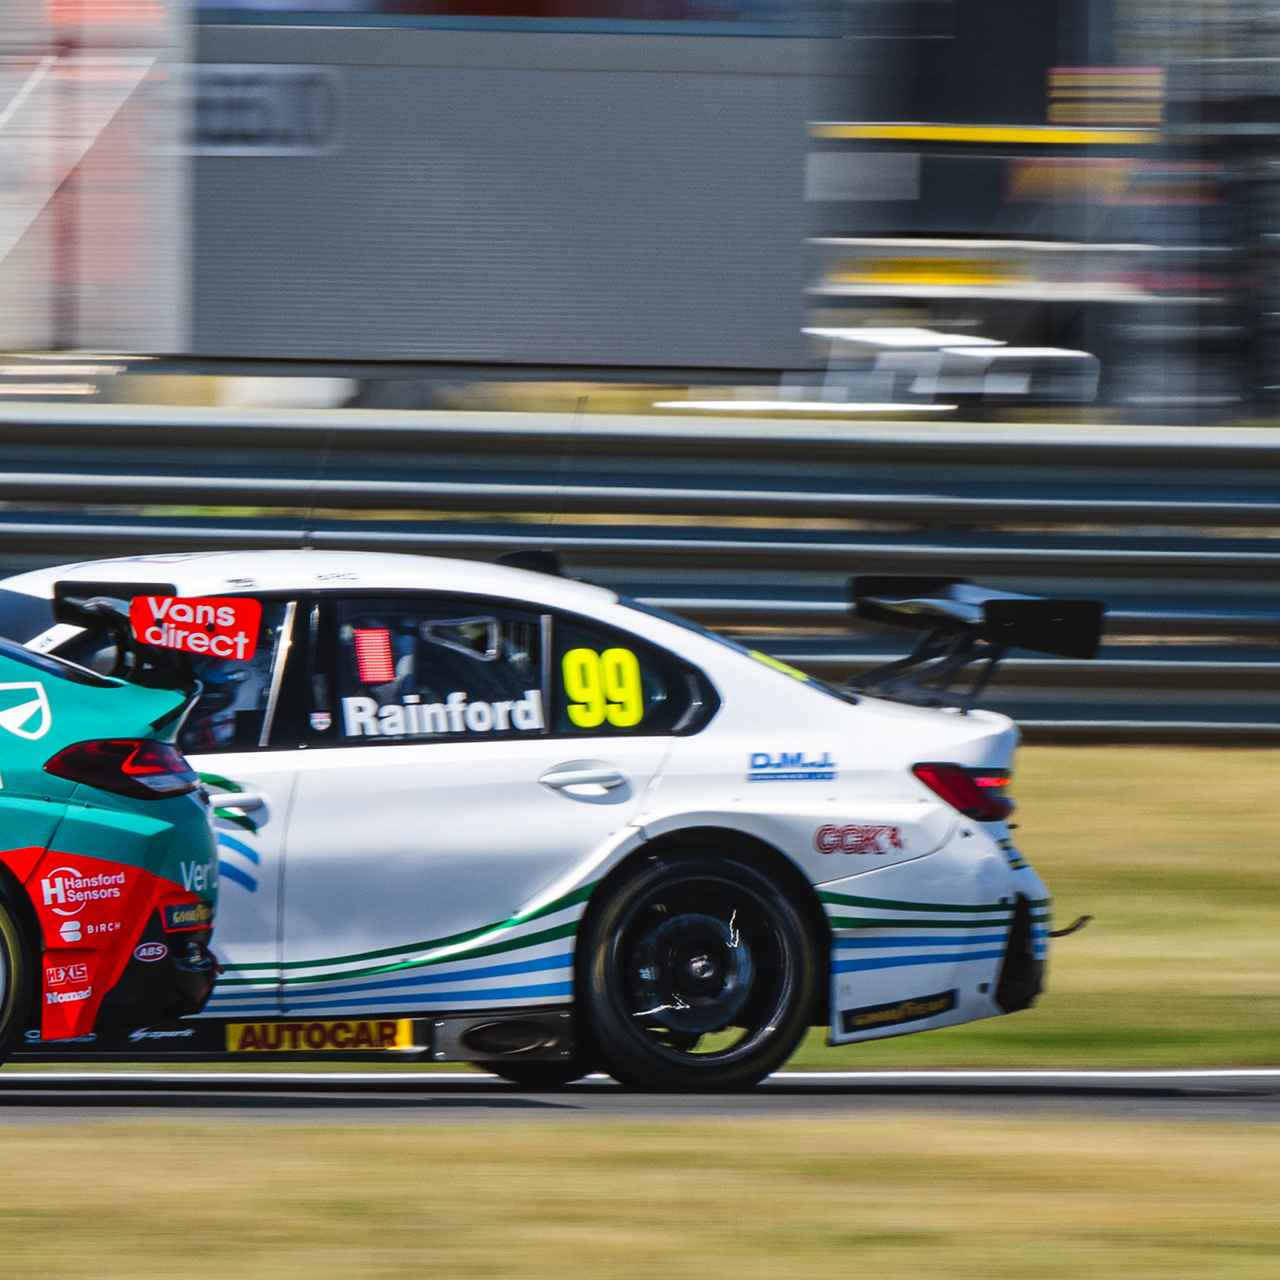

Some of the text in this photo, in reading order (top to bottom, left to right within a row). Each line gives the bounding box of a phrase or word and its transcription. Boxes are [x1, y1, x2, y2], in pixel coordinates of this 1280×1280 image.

[147, 597, 236, 627] Vans
[144, 623, 249, 659] direct
[561, 648, 644, 728] 99
[342, 689, 545, 737] Rainford
[64, 871, 126, 890] Hansford
[66, 887, 121, 903] Sensors
[86, 922, 121, 934] BIRCH
[139, 945, 163, 957] ABS
[46, 964, 88, 984] HEXIS
[46, 986, 92, 1004] Nomad
[239, 1019, 398, 1052] AUTOCAR
